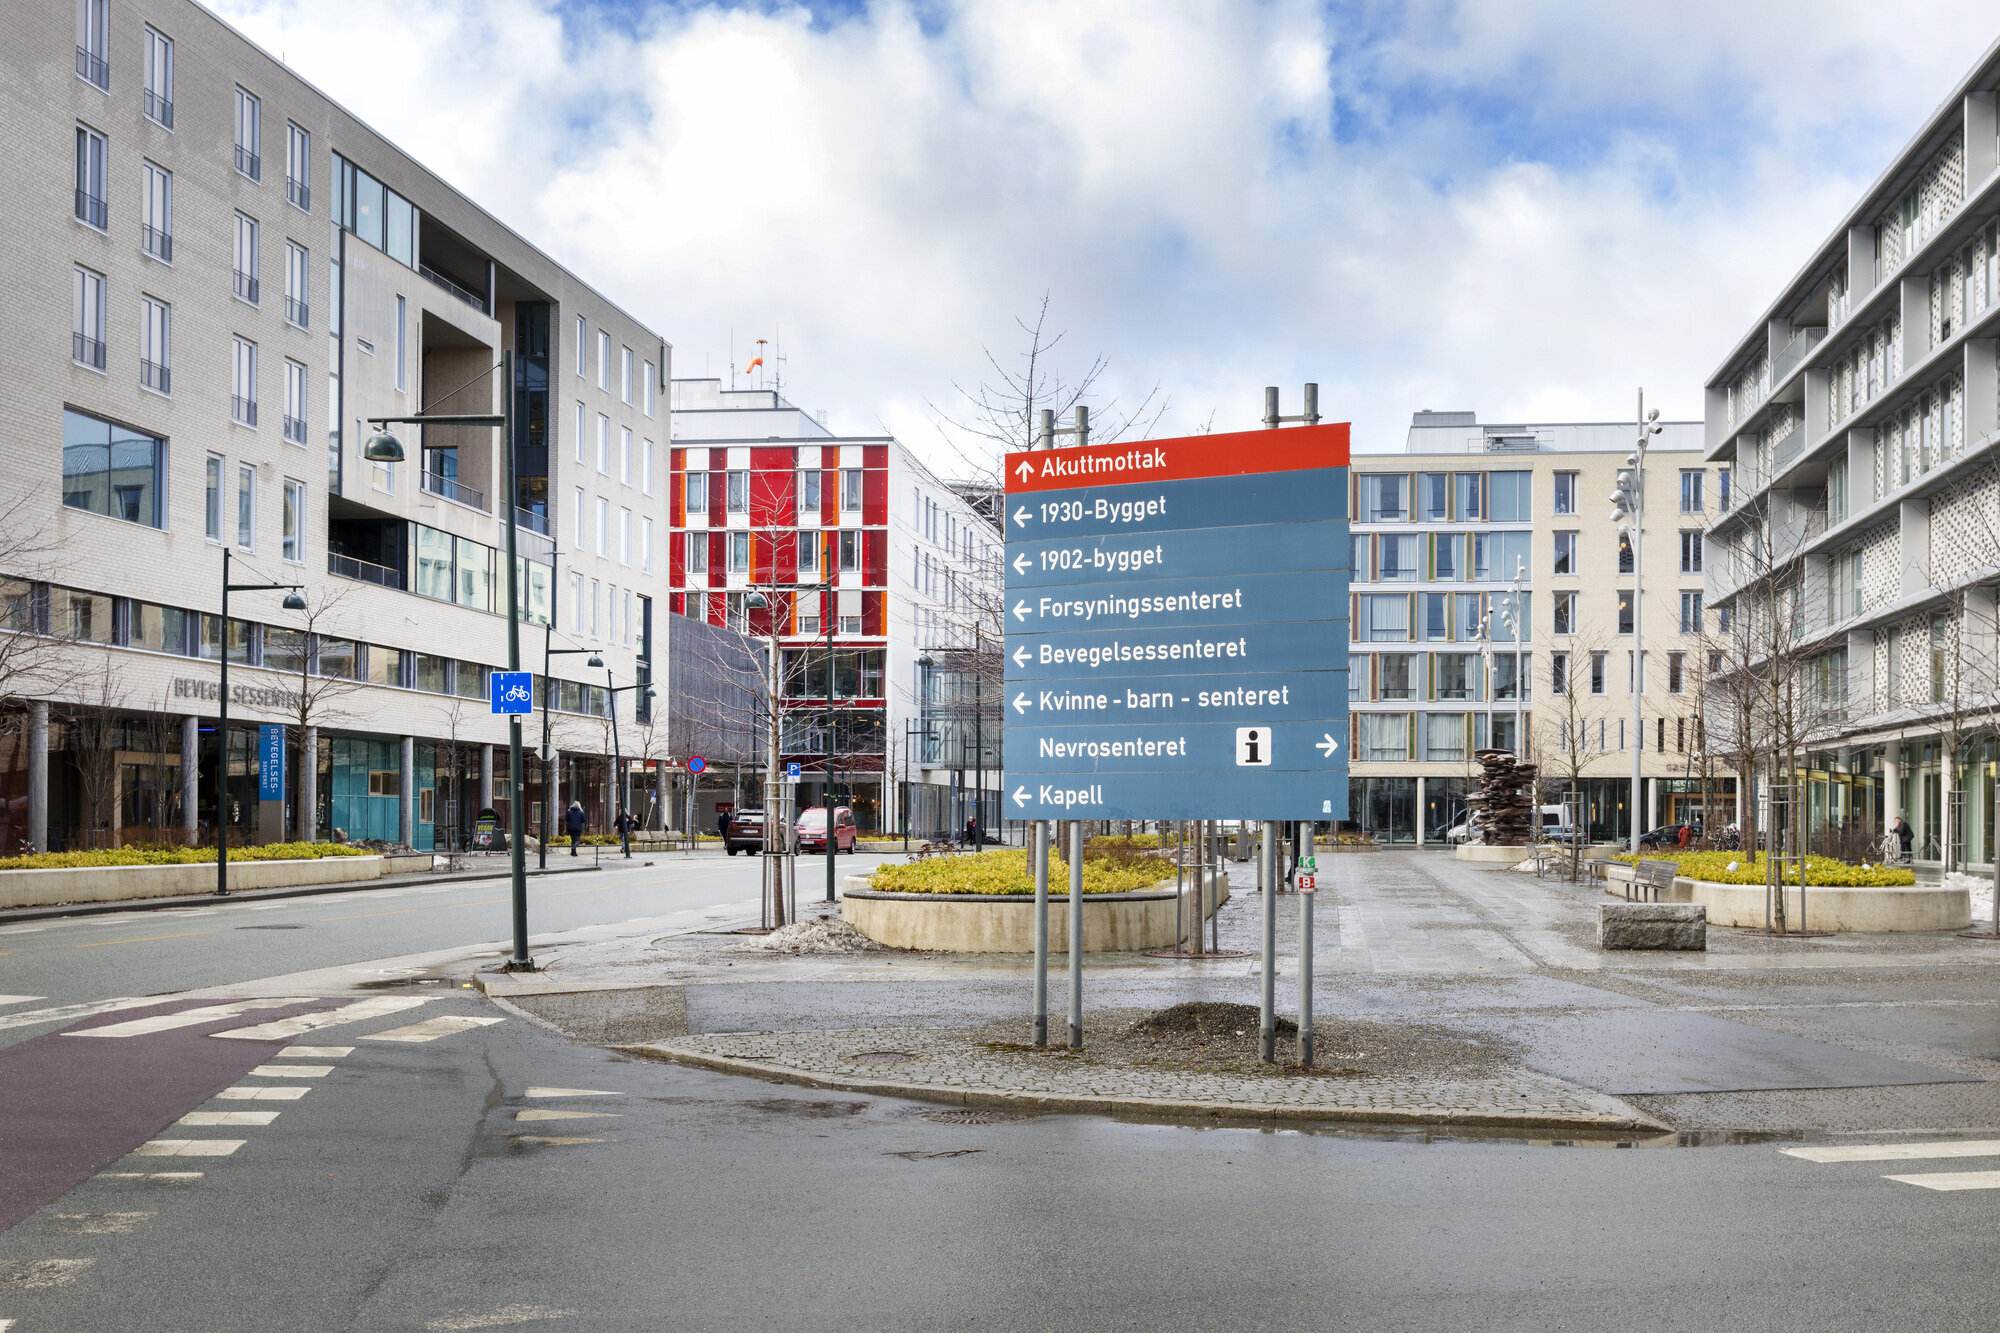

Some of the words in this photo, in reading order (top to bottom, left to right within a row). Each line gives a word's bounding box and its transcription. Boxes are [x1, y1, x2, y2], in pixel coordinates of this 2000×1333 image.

[1040, 447, 1167, 477] Akuttmottak
[1040, 495, 1167, 524] 1930-Bygget
[1040, 545, 1163, 573] 1902-bygget
[1039, 588, 1243, 620] Forsyningssenteret
[1039, 637, 1247, 668] Bevegelsessenteret
[1039, 690, 1108, 711] Kvinne
[1126, 689, 1174, 708] barn
[1197, 685, 1289, 707] senteret
[270, 728, 279, 793] BEVEGELSES-
[1039, 737, 1187, 758] Nevrosenteret
[1039, 785, 1104, 809] Kapell
[1302, 856, 1312, 867] K
[1302, 877, 1311, 888] B
